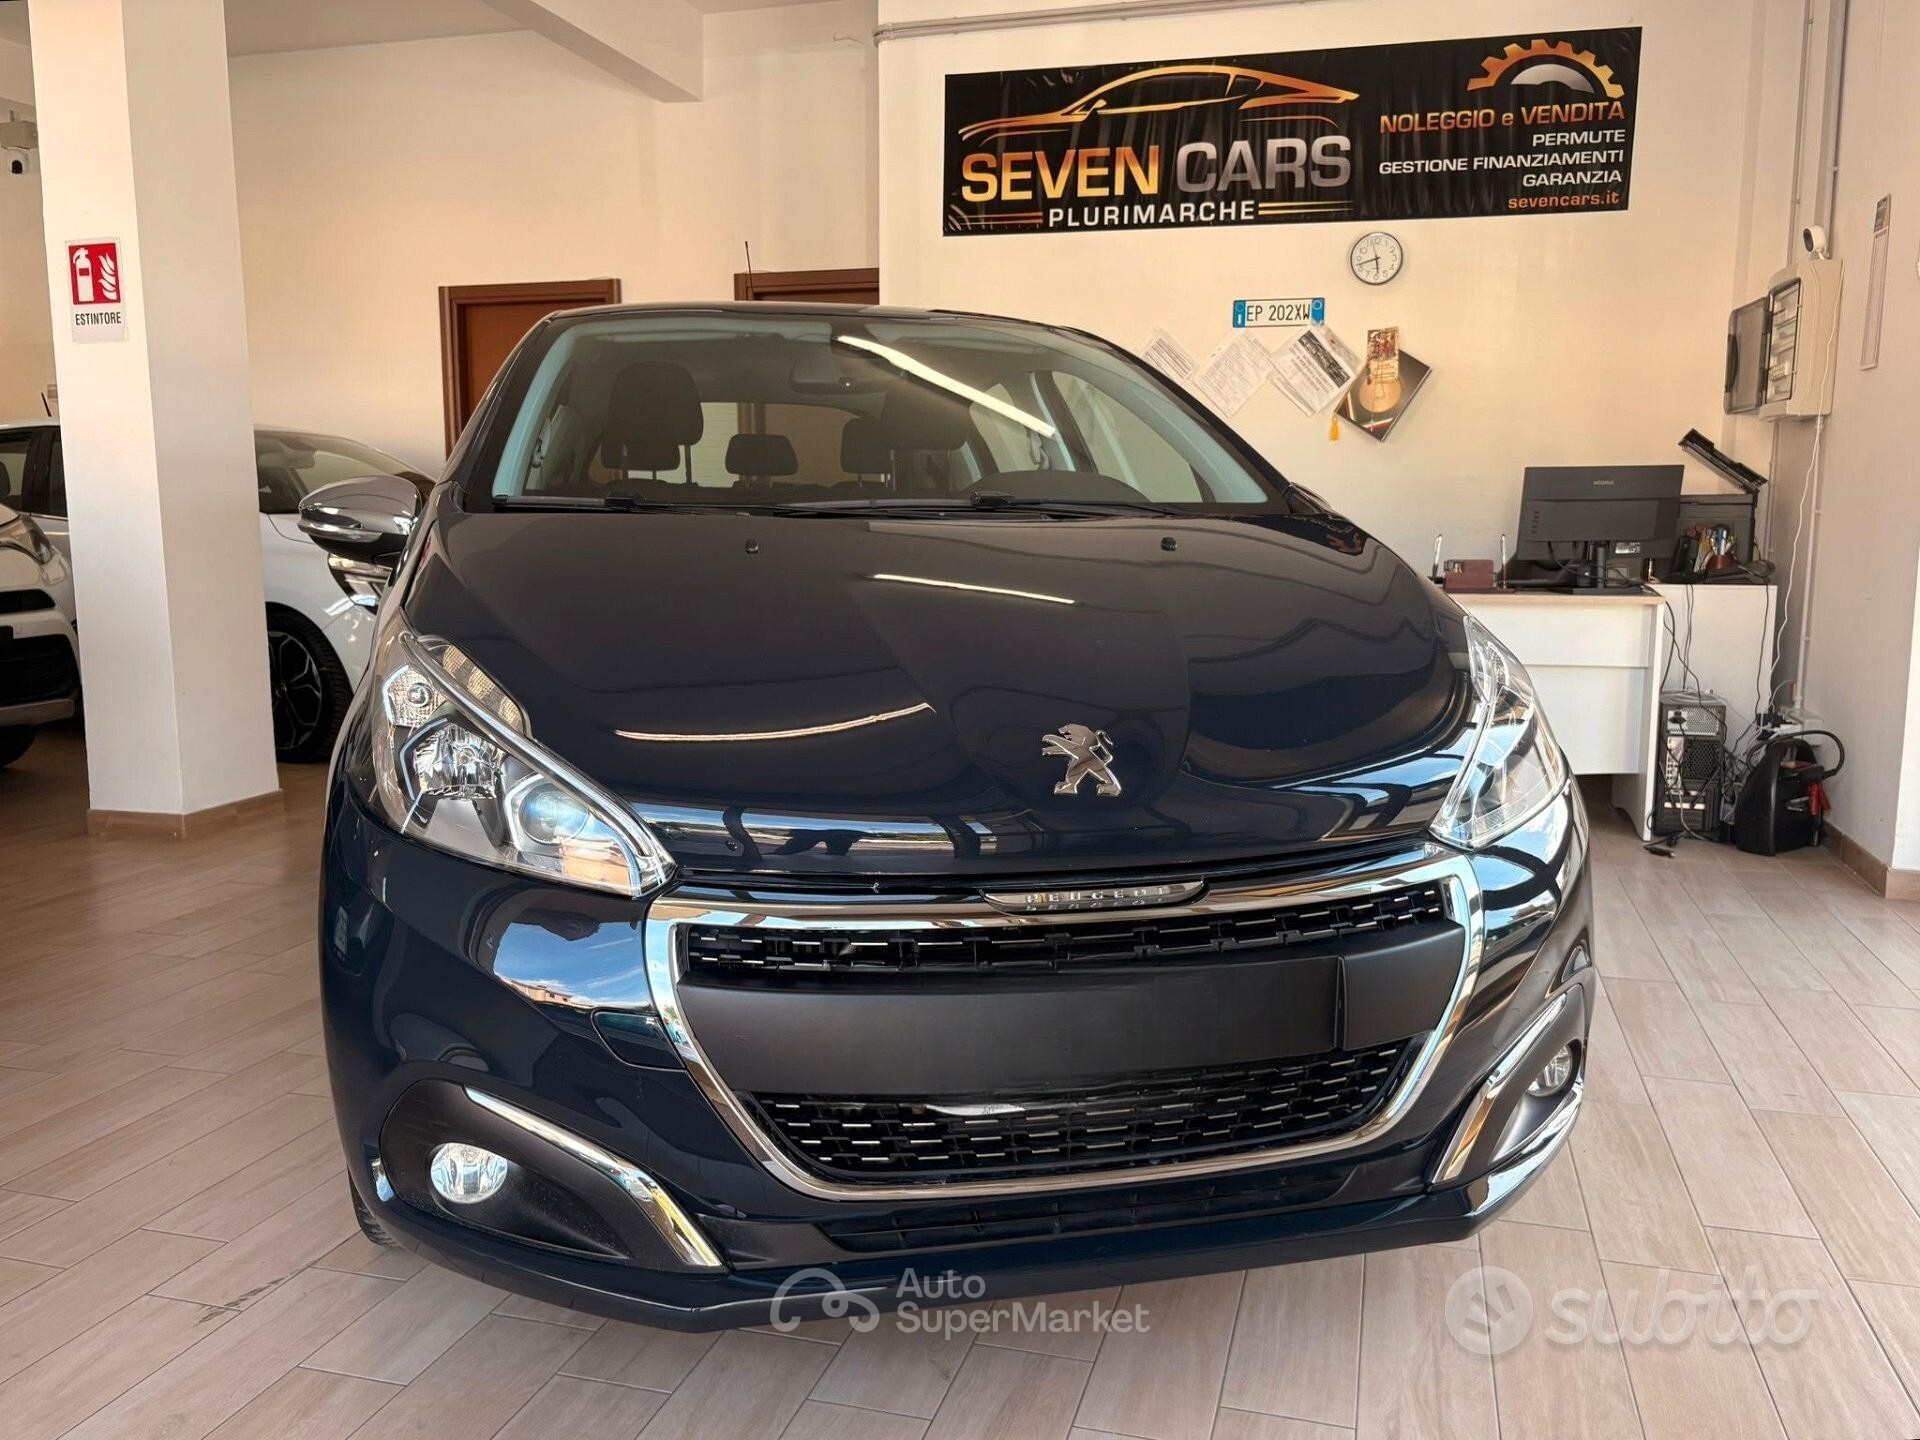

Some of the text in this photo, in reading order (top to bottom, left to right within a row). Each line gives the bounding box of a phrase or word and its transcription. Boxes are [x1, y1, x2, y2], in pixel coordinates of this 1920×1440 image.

[1380, 101, 1625, 133] NOLEGGIO e VENDITA
[1532, 129, 1626, 147] PERMUTE
[961, 135, 1351, 202] SEVEN CARS
[1379, 150, 1624, 175] GESTIONE FINANZIAMENTI
[1522, 170, 1622, 188] GARANZIA
[1508, 191, 1620, 209] sevencars.it
[1048, 200, 1255, 228] PLURIMARCHE
[75, 311, 122, 326] ESTINTORE
[1246, 304, 1311, 321] EP 202XW
